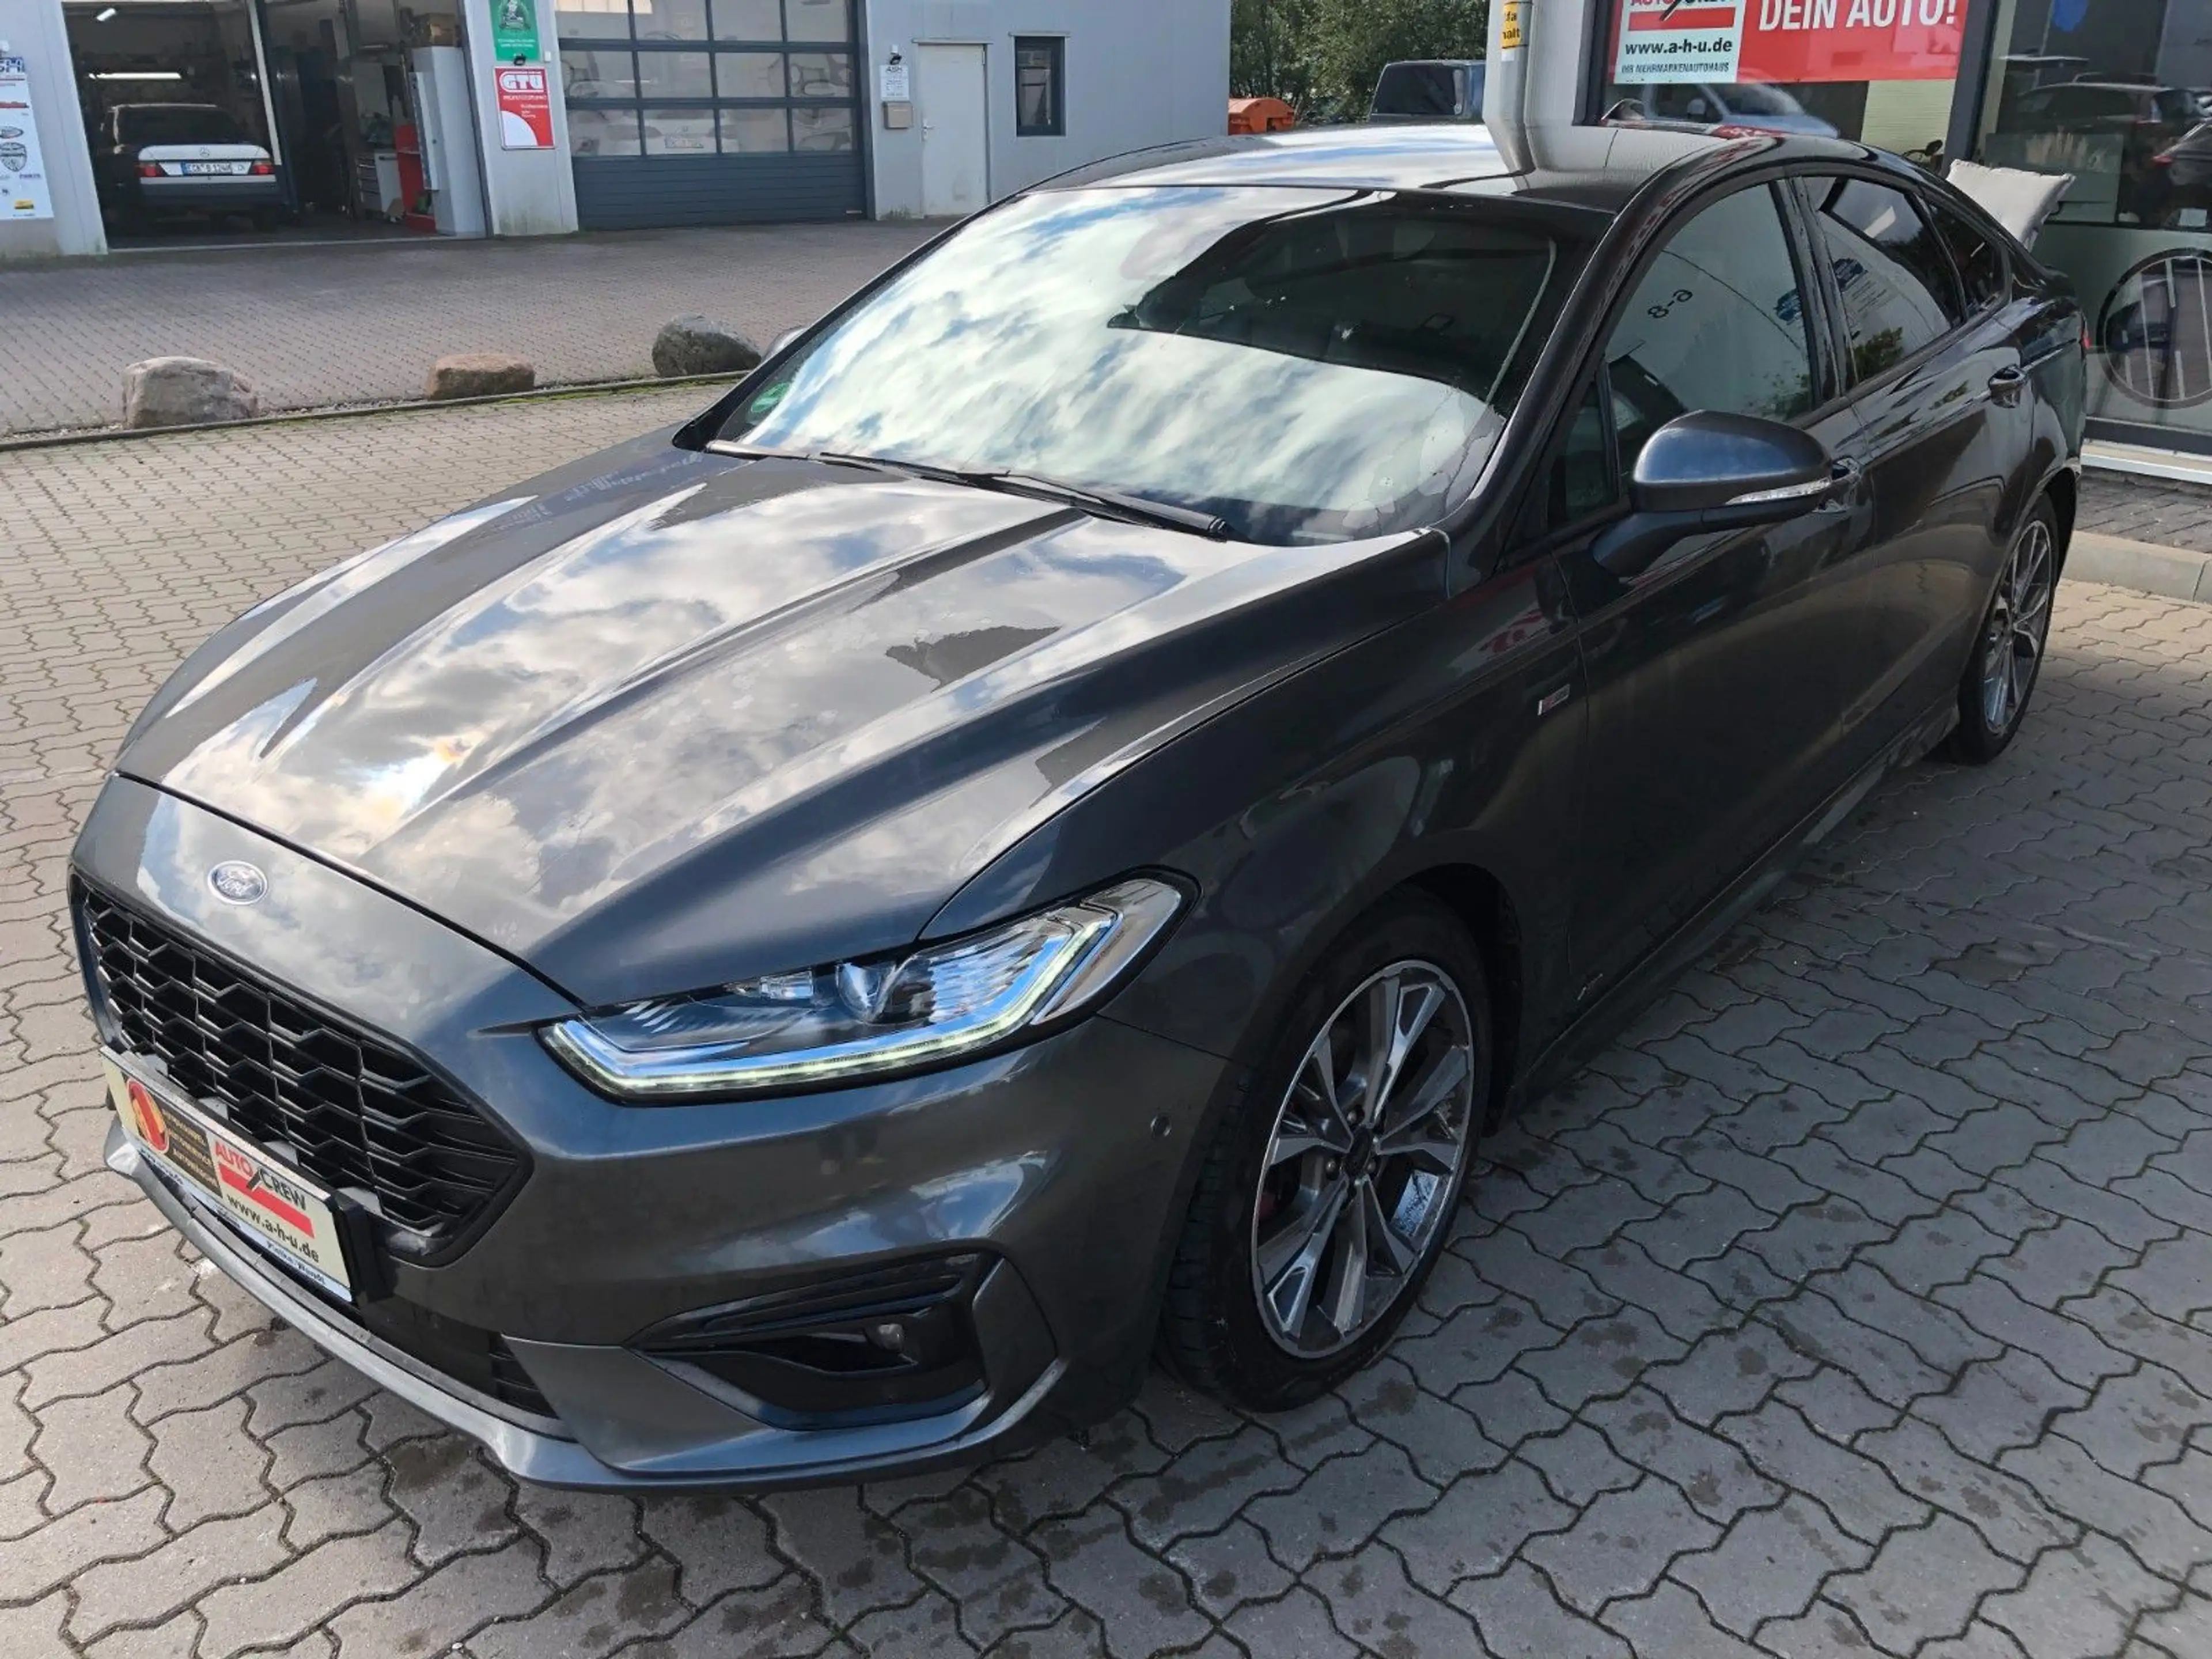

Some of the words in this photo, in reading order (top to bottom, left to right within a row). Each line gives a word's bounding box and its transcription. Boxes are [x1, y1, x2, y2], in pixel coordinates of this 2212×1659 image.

[1759, 0, 1837, 31] DEIN
[1846, 0, 1956, 27] AUTO!
[1626, 38, 1733, 55] www.a-h-u.de
[1636, 62, 1729, 73] MEHRMARKENAUTOHAUS
[214, 1141, 253, 1177] AUTO
[259, 1167, 306, 1211] CREW
[227, 1195, 319, 1264] www.a-h-u.de
